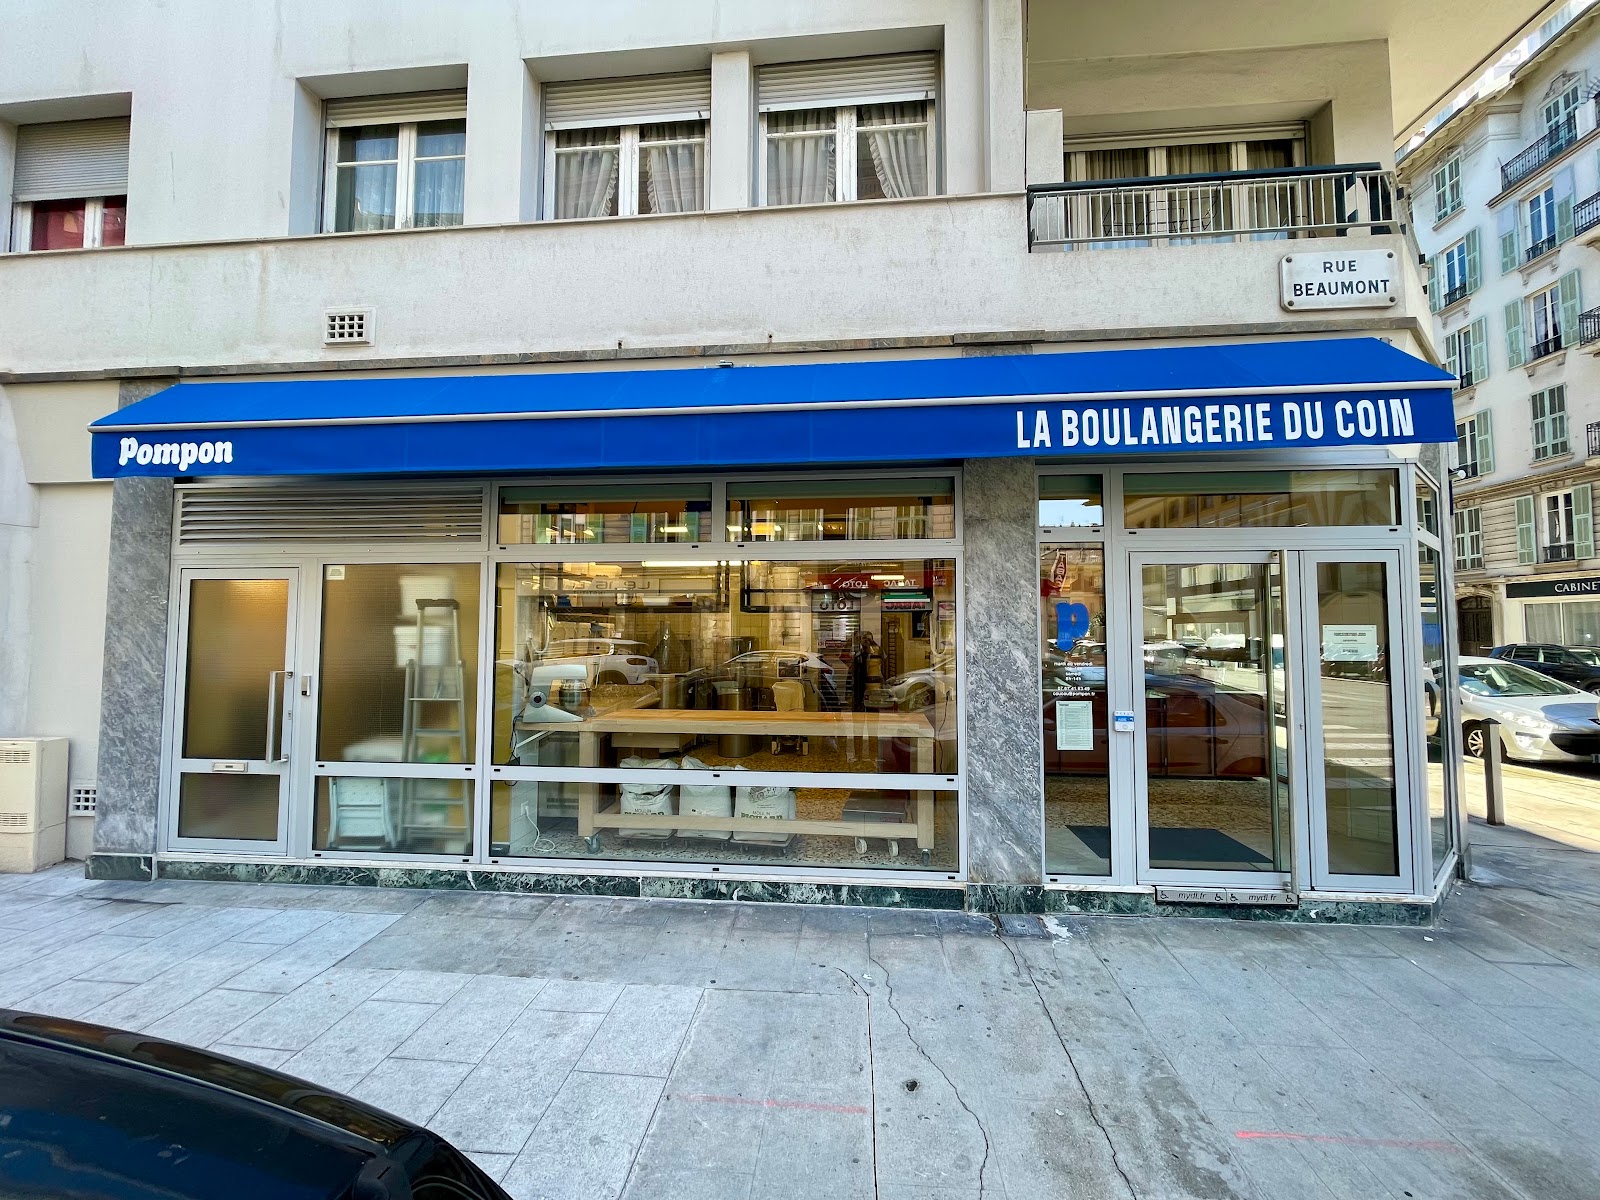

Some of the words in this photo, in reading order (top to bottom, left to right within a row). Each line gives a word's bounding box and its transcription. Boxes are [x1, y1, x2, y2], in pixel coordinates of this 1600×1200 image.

[1323, 260, 1357, 273] RUE
[1293, 278, 1390, 297] BEAUMONT
[1016, 410, 1051, 448] LA
[1062, 403, 1273, 446] BOULANGERIE
[1283, 401, 1324, 440] DU
[1335, 398, 1414, 438] COIN
[118, 436, 233, 471] Pompon
